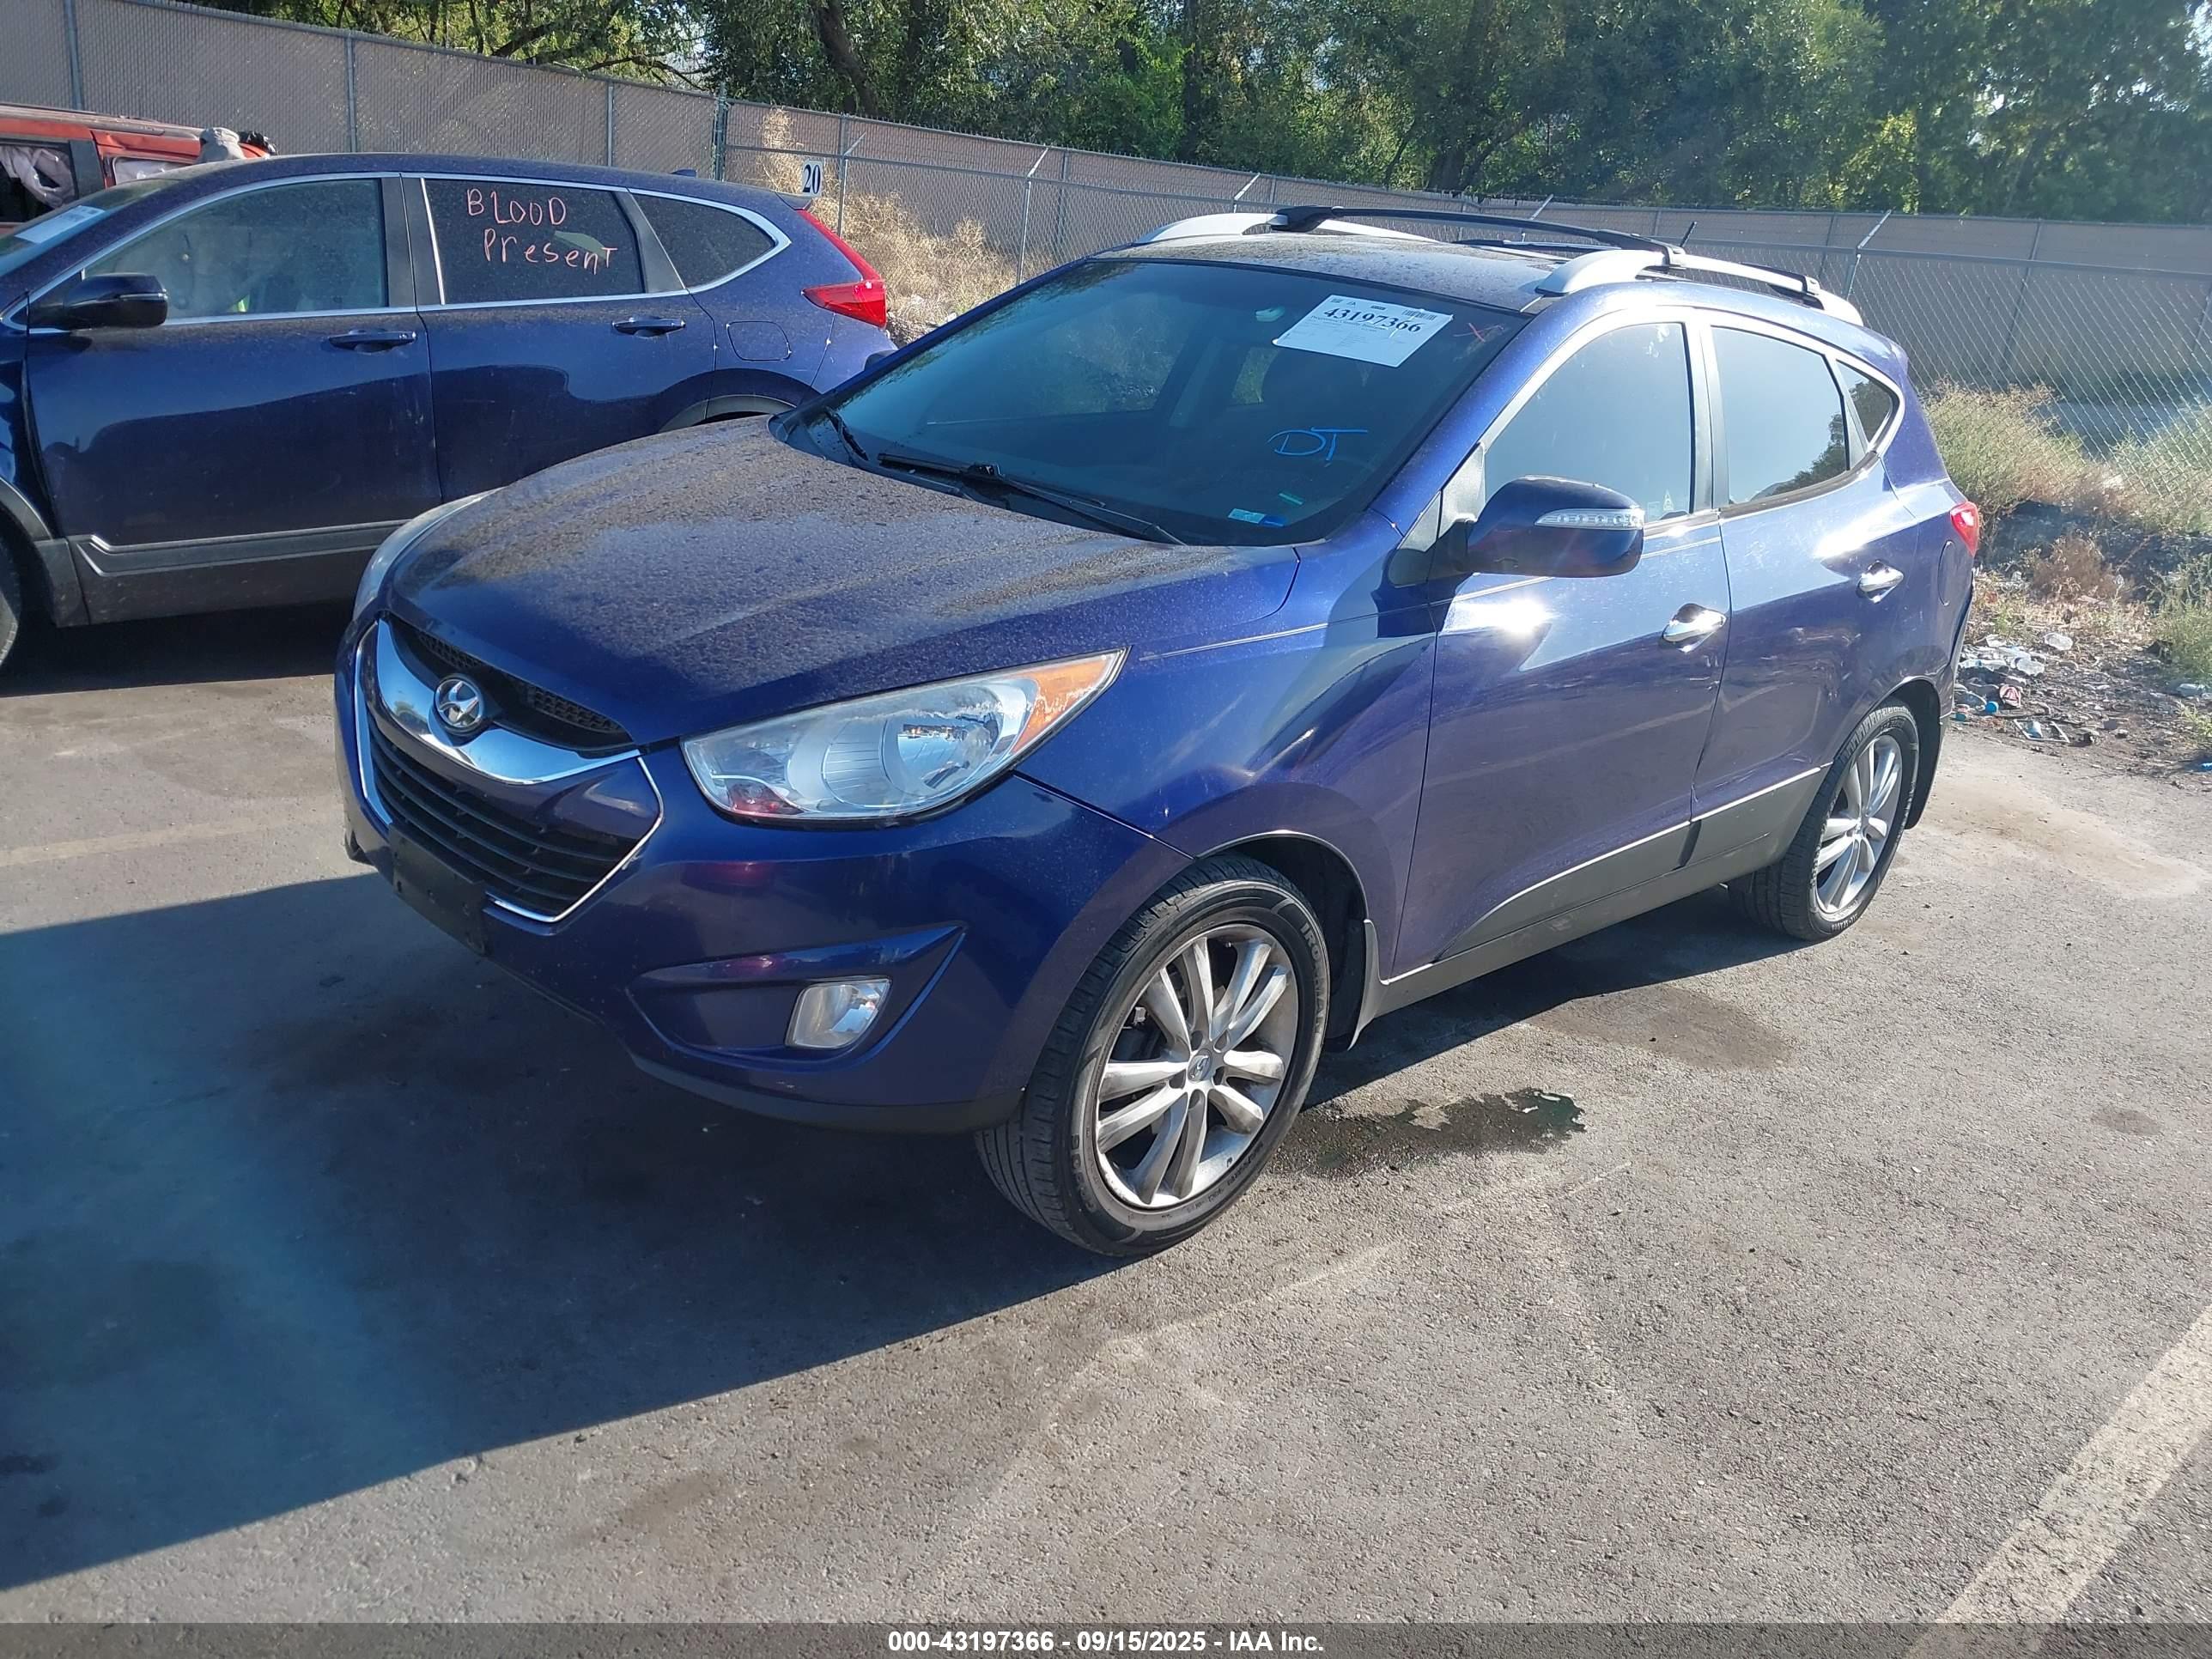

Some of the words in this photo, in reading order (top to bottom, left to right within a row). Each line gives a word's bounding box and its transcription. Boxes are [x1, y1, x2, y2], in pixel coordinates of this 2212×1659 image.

[802, 164, 821, 194] 20
[466, 188, 567, 226] BLOOD
[1323, 307, 1423, 333] 43197366
[1267, 426, 1369, 468] DT
